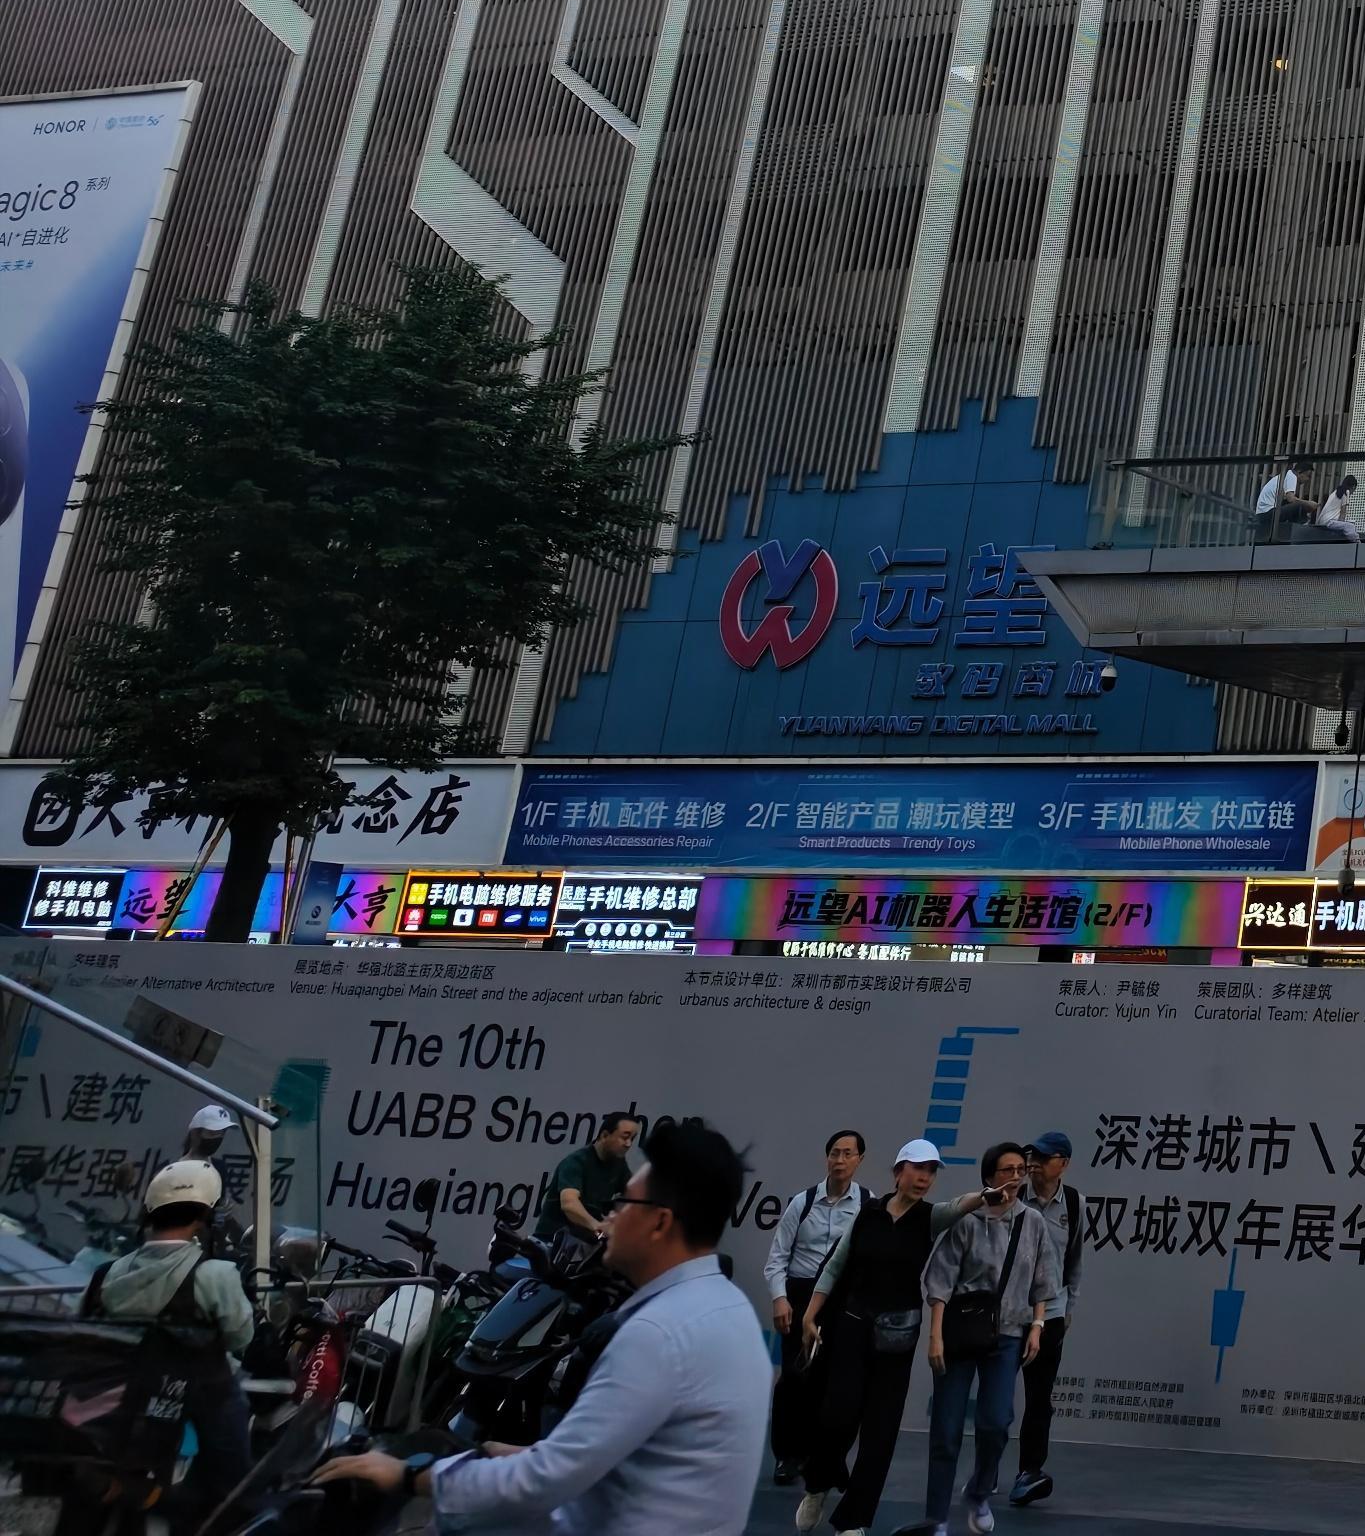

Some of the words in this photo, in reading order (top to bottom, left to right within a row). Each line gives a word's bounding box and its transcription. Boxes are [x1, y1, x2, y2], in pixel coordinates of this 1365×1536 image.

[33, 120, 85, 135] HONOR
[85, 177, 111, 191] 系列
[850, 542, 1056, 650] 远望
[910, 662, 1102, 697] 数码商城
[777, 714, 922, 736] YUANWANG
[927, 714, 1024, 736] DIGITAL
[1026, 713, 1100, 734] MALL
[521, 801, 556, 827] 1/F
[562, 800, 610, 828] 手机
[618, 800, 669, 828] 配件
[673, 800, 727, 829] 维修
[745, 802, 789, 829] 2/F
[795, 801, 900, 830] 智能产品
[906, 801, 1016, 830] 潮玩模型
[1038, 802, 1084, 829] 3/F
[1091, 801, 1205, 831] 手机批发
[1211, 800, 1296, 830] 供应链
[523, 834, 559, 847] Mobile
[561, 834, 603, 848] Phones
[604, 835, 674, 849] Accessories
[676, 836, 714, 851] Repair
[799, 837, 835, 849] Smart
[836, 837, 890, 850] Products
[902, 837, 944, 853] Trendy
[946, 837, 976, 852] Toys
[1119, 837, 1161, 850] Mobile
[1163, 837, 1203, 850] Phone
[1205, 837, 1270, 851] Wholesale
[120, 876, 191, 924] 远望
[331, 879, 396, 928] 大亨
[428, 883, 553, 907] 手机电脑维修服务
[587, 885, 698, 911] 手机维修总部
[34, 899, 113, 917] 修手机电脑
[1243, 901, 1310, 927] 兴达通
[141, 978, 202, 991] Alternative
[205, 978, 275, 993] Architecture
[290, 981, 327, 995] Venue:
[332, 982, 405, 1001] Huaqiangbei
[408, 985, 437, 999] Main
[441, 986, 477, 1001] Street
[481, 988, 503, 1001] and
[508, 989, 528, 1002] the
[531, 989, 584, 1006] adjacent
[587, 991, 624, 1005] urban
[628, 991, 664, 1006] fabric
[1197, 981, 1333, 1001] 策展团队：多样建筑
[680, 994, 729, 1008] urbanus
[733, 996, 809, 1011] architecture
[814, 999, 824, 1010] &
[829, 998, 871, 1014] design
[1055, 1002, 1109, 1018] Curator:
[1115, 1003, 1151, 1023] Yujun
[1157, 1004, 1178, 1019] Yin
[1194, 1004, 1262, 1021] Curatorial
[1267, 1005, 1308, 1021] Team:
[1312, 1007, 1360, 1023] Atelier
[369, 1020, 443, 1066] The
[456, 1023, 546, 1071] 10th
[347, 1090, 477, 1141] UABB
